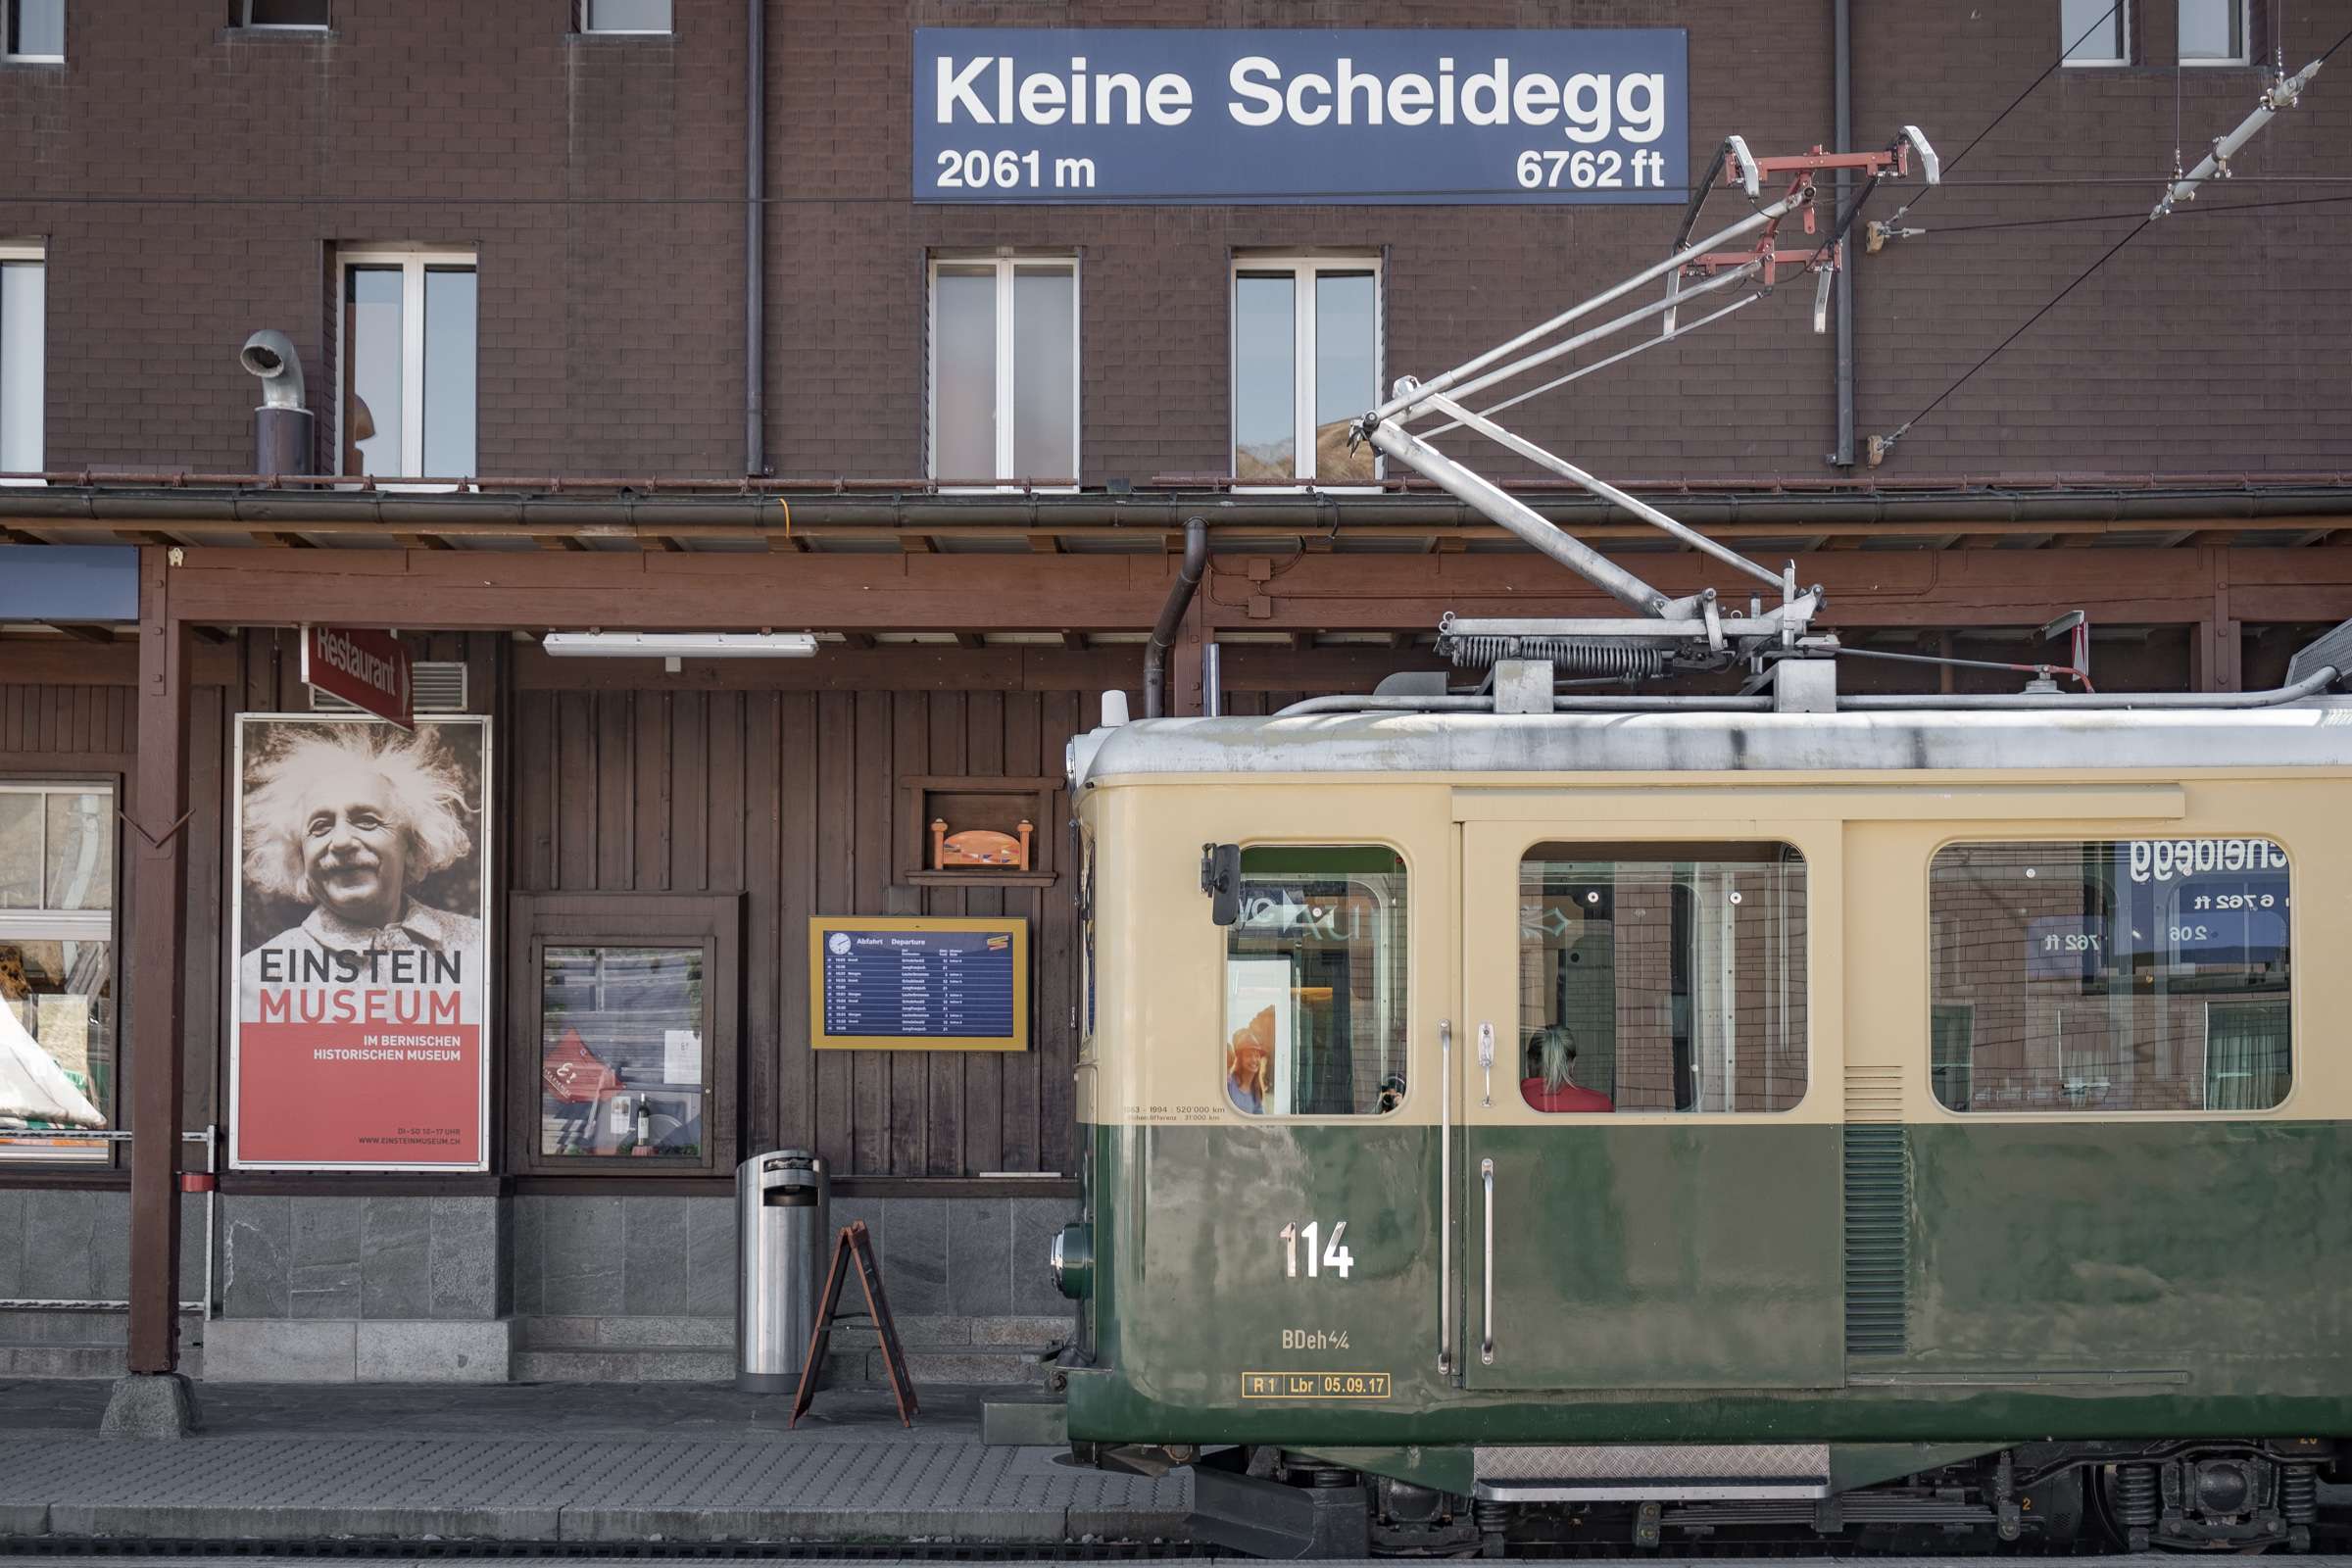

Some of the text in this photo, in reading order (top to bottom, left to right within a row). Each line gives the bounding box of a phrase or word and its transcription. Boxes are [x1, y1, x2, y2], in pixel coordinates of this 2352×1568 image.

[937, 56, 1666, 144] Kleine Scheidegg
[936, 149, 1096, 188] 2061 m
[1515, 149, 1665, 188] 6762 ft
[317, 627, 396, 697] Restaurant
[891, 938, 926, 947] Departure
[260, 949, 461, 984] EINSTEIN
[260, 989, 461, 1025] MUSEUM
[364, 1035, 461, 1047] IM BERNISCHEN
[314, 1049, 461, 1061] HISTORISCHEN MUSEUM
[359, 1136, 461, 1146] WWW.EINSTEINMUSEUM.CH
[1279, 1221, 1354, 1278] 114
[1253, 1377, 1275, 1394] R 1
[1290, 1377, 1314, 1394] Lbr
[1324, 1377, 1385, 1394] 05.09.17
[2022, 1496, 2032, 1511] 2
